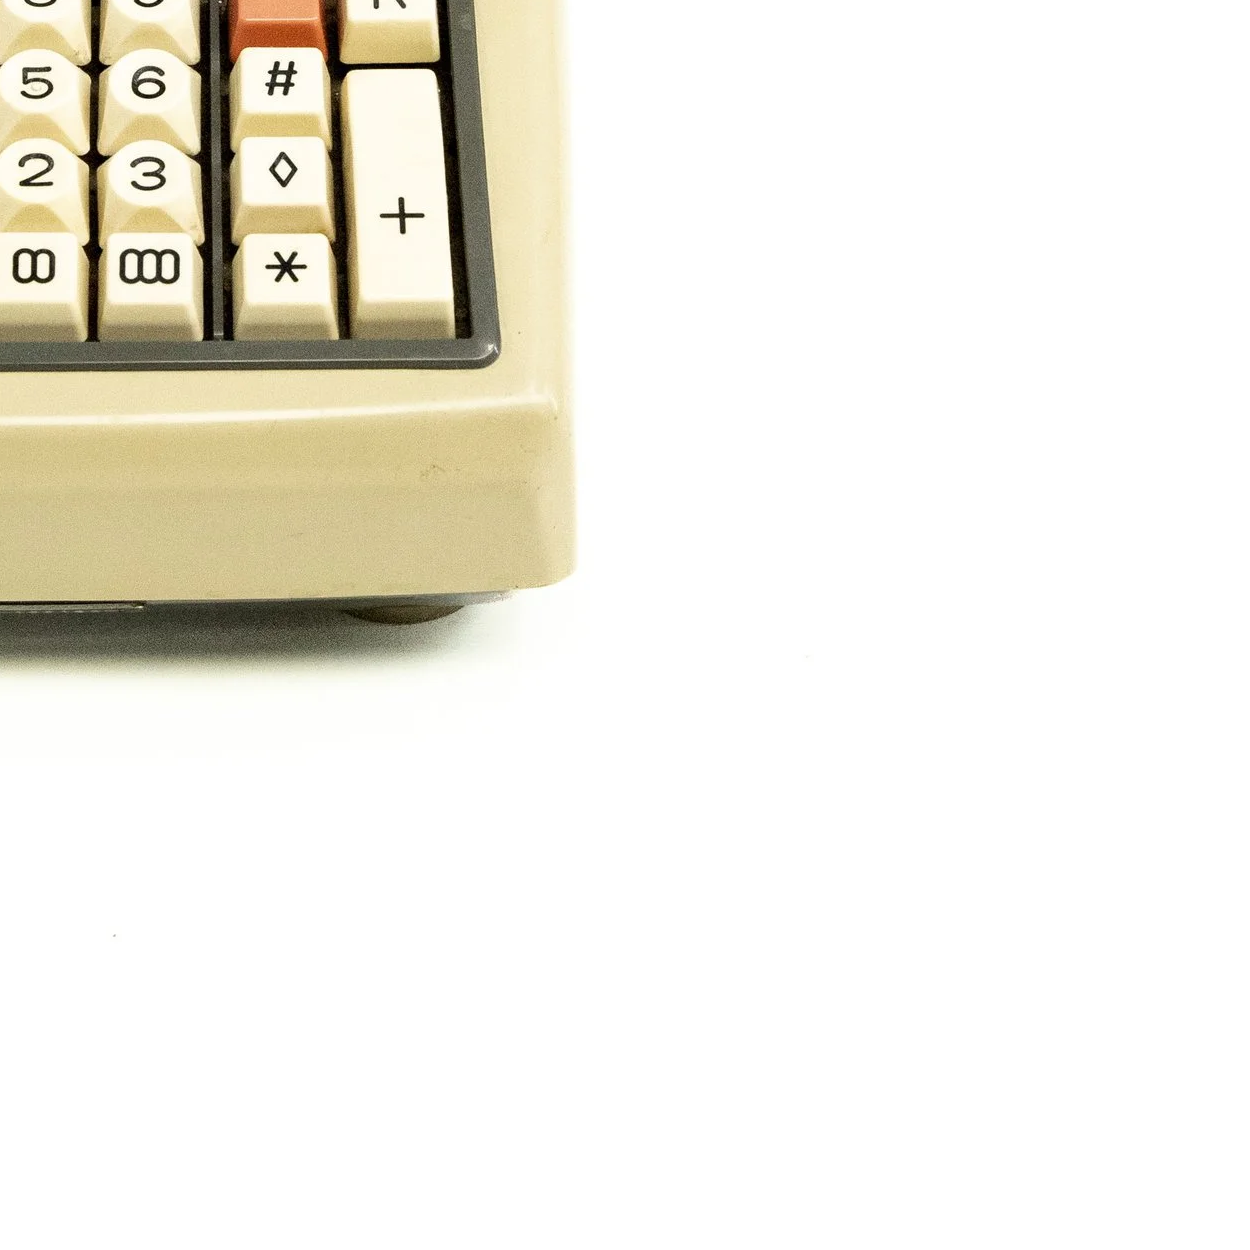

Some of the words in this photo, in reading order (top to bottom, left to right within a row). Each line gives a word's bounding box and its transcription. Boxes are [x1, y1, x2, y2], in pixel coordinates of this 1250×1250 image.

[21, 67, 53, 99] 5
[132, 66, 165, 99] 6
[19, 153, 54, 186] 2
[130, 157, 166, 191] 3
